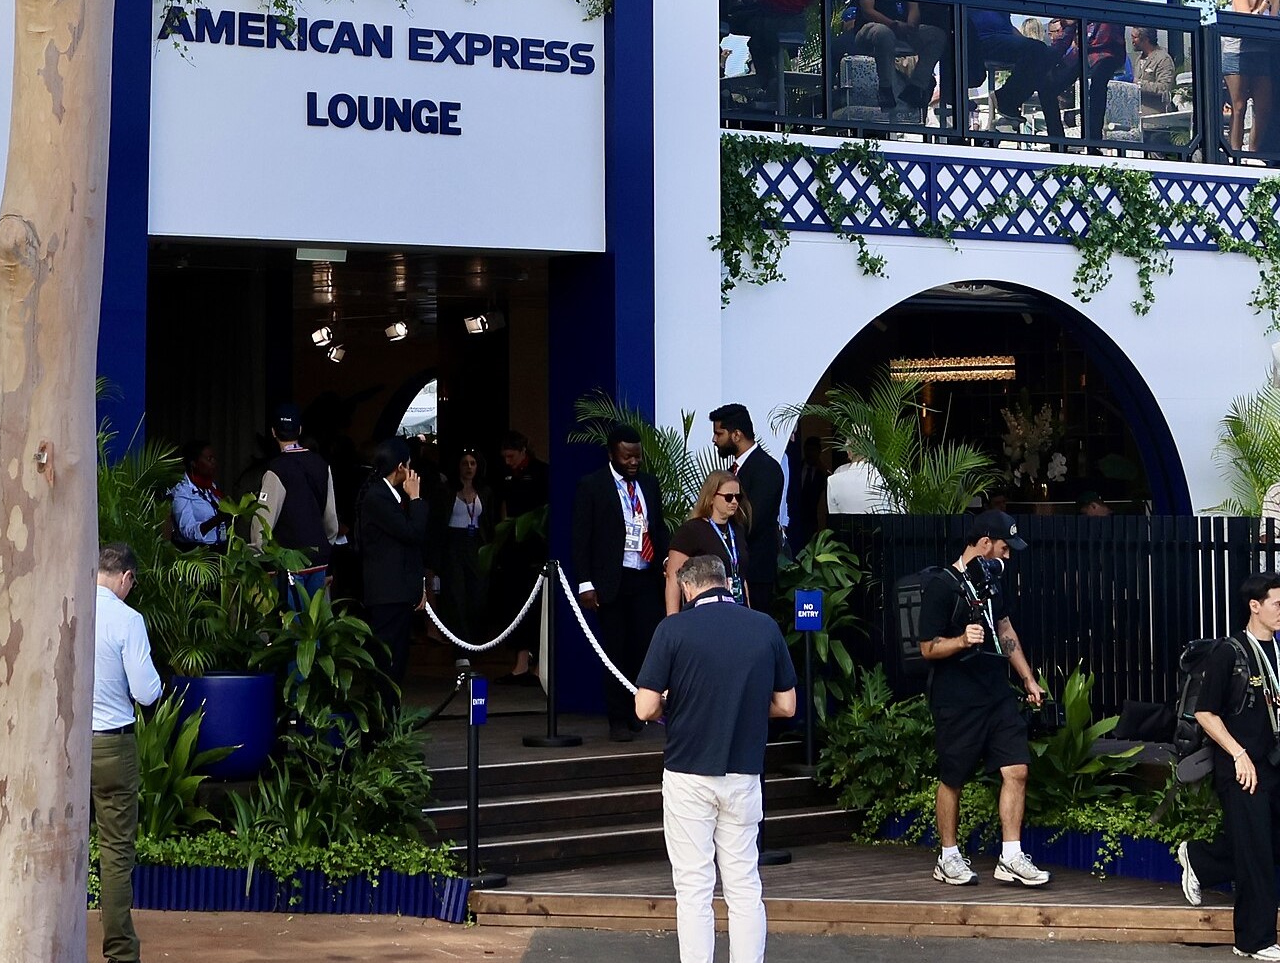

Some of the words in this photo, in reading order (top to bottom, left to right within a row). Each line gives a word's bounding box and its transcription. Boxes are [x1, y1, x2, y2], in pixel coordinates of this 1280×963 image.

[158, 5, 393, 59] AMERICAN
[408, 26, 596, 75] EXPRESS
[306, 91, 462, 136] LOUNGE
[803, 603, 814, 611] NO
